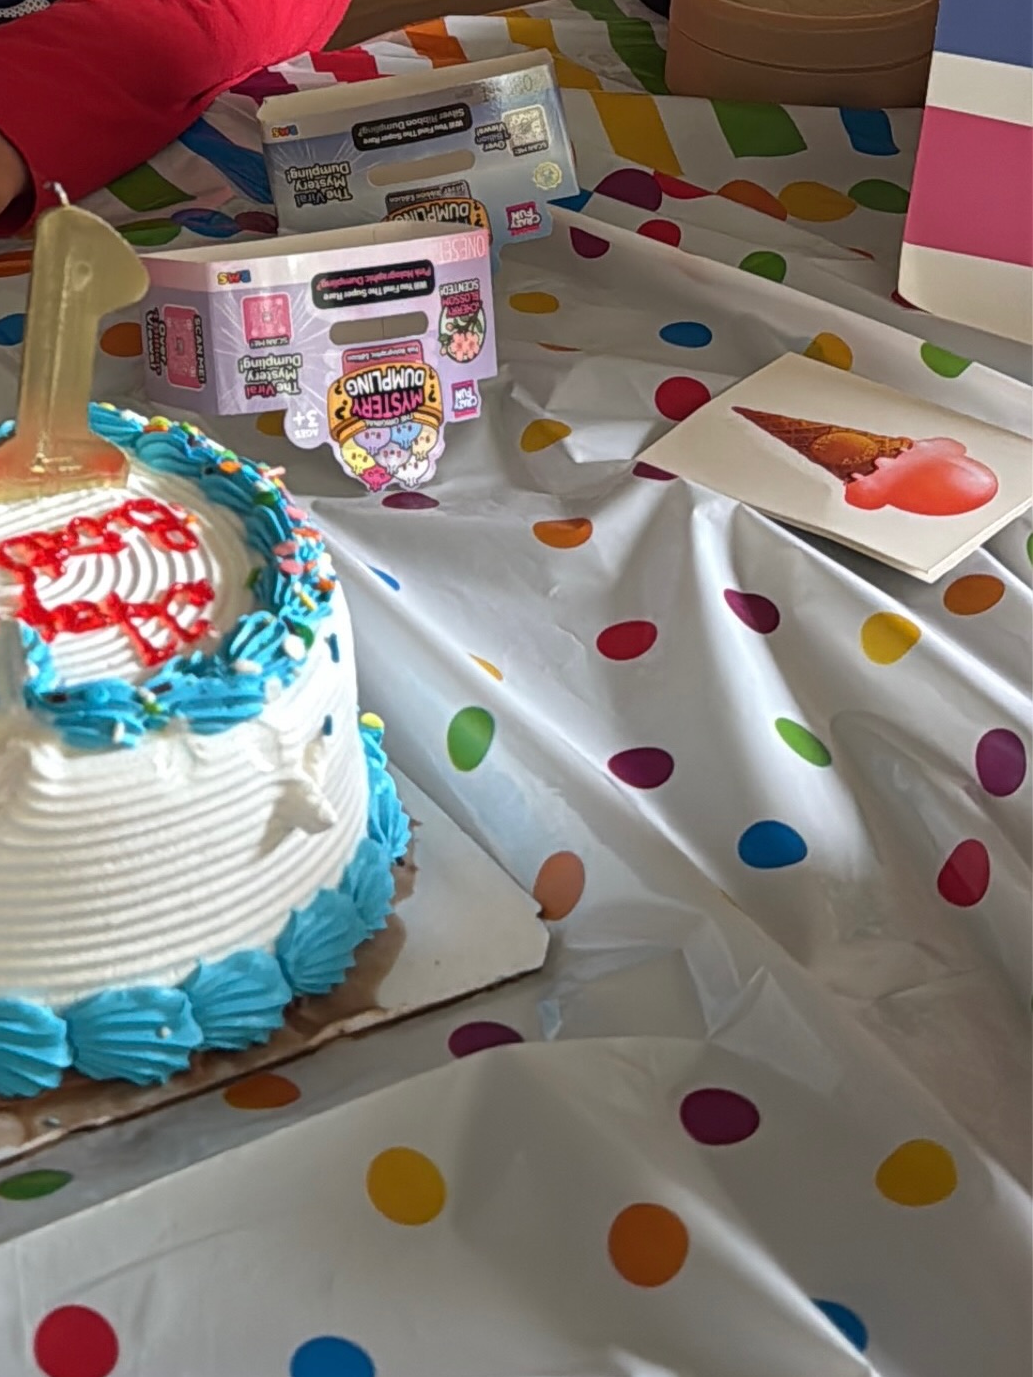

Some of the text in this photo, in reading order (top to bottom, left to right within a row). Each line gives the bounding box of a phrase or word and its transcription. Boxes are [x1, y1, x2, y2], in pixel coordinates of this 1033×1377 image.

[476, 123, 505, 136] Views!
[484, 141, 505, 151] Over
[286, 163, 350, 182] Dumpling!
[295, 177, 346, 192] Mystery
[295, 188, 351, 207] The Viral
[511, 207, 533, 219] FUN
[511, 214, 540, 228] CRAZY
[343, 288, 367, 298] Super
[367, 286, 383, 295] The
[382, 284, 399, 293] Find
[399, 283, 413, 291] You
[439, 279, 479, 295] SCENTED!
[194, 316, 205, 383] SCAN ME!
[238, 354, 301, 371] Dumpling!
[246, 368, 296, 382] Mystery
[346, 367, 425, 396] DUMPLING
[246, 381, 299, 398] The Viral
[455, 387, 472, 399] FUN
[352, 389, 423, 419] MYSTERY
[293, 409, 319, 428] 3+
[294, 428, 319, 439] AGES
